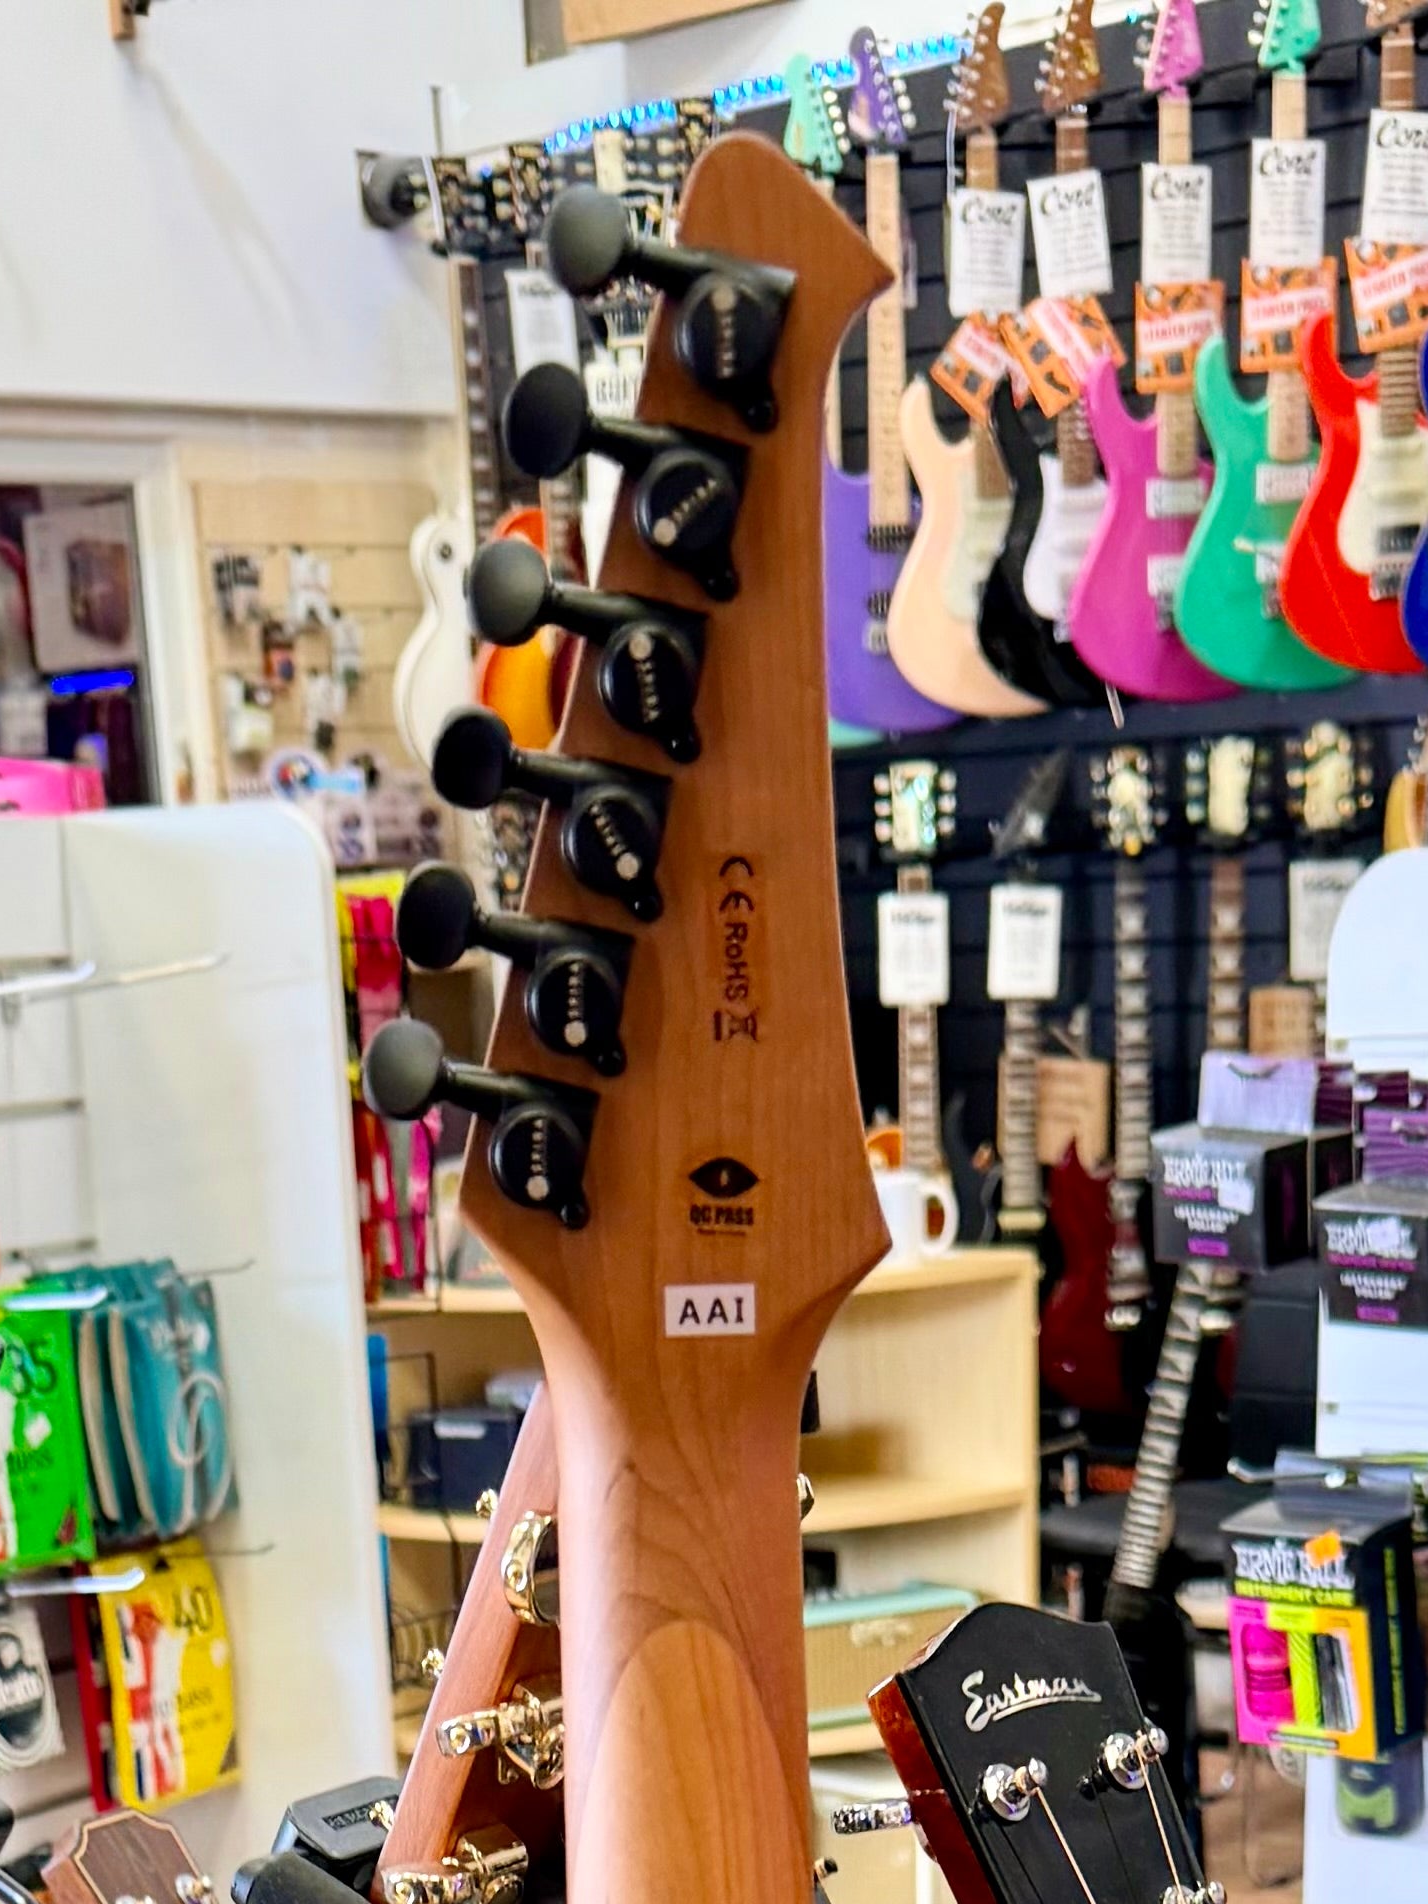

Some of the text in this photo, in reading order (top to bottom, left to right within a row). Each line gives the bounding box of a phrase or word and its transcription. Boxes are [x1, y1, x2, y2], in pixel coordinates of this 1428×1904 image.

[724, 922, 749, 1002] RoHS
[714, 1204, 755, 1229] PASS
[1232, 1537, 1297, 1584] ERNIE
[174, 1587, 213, 1633] 40
[961, 1669, 1101, 1732] Eastman
